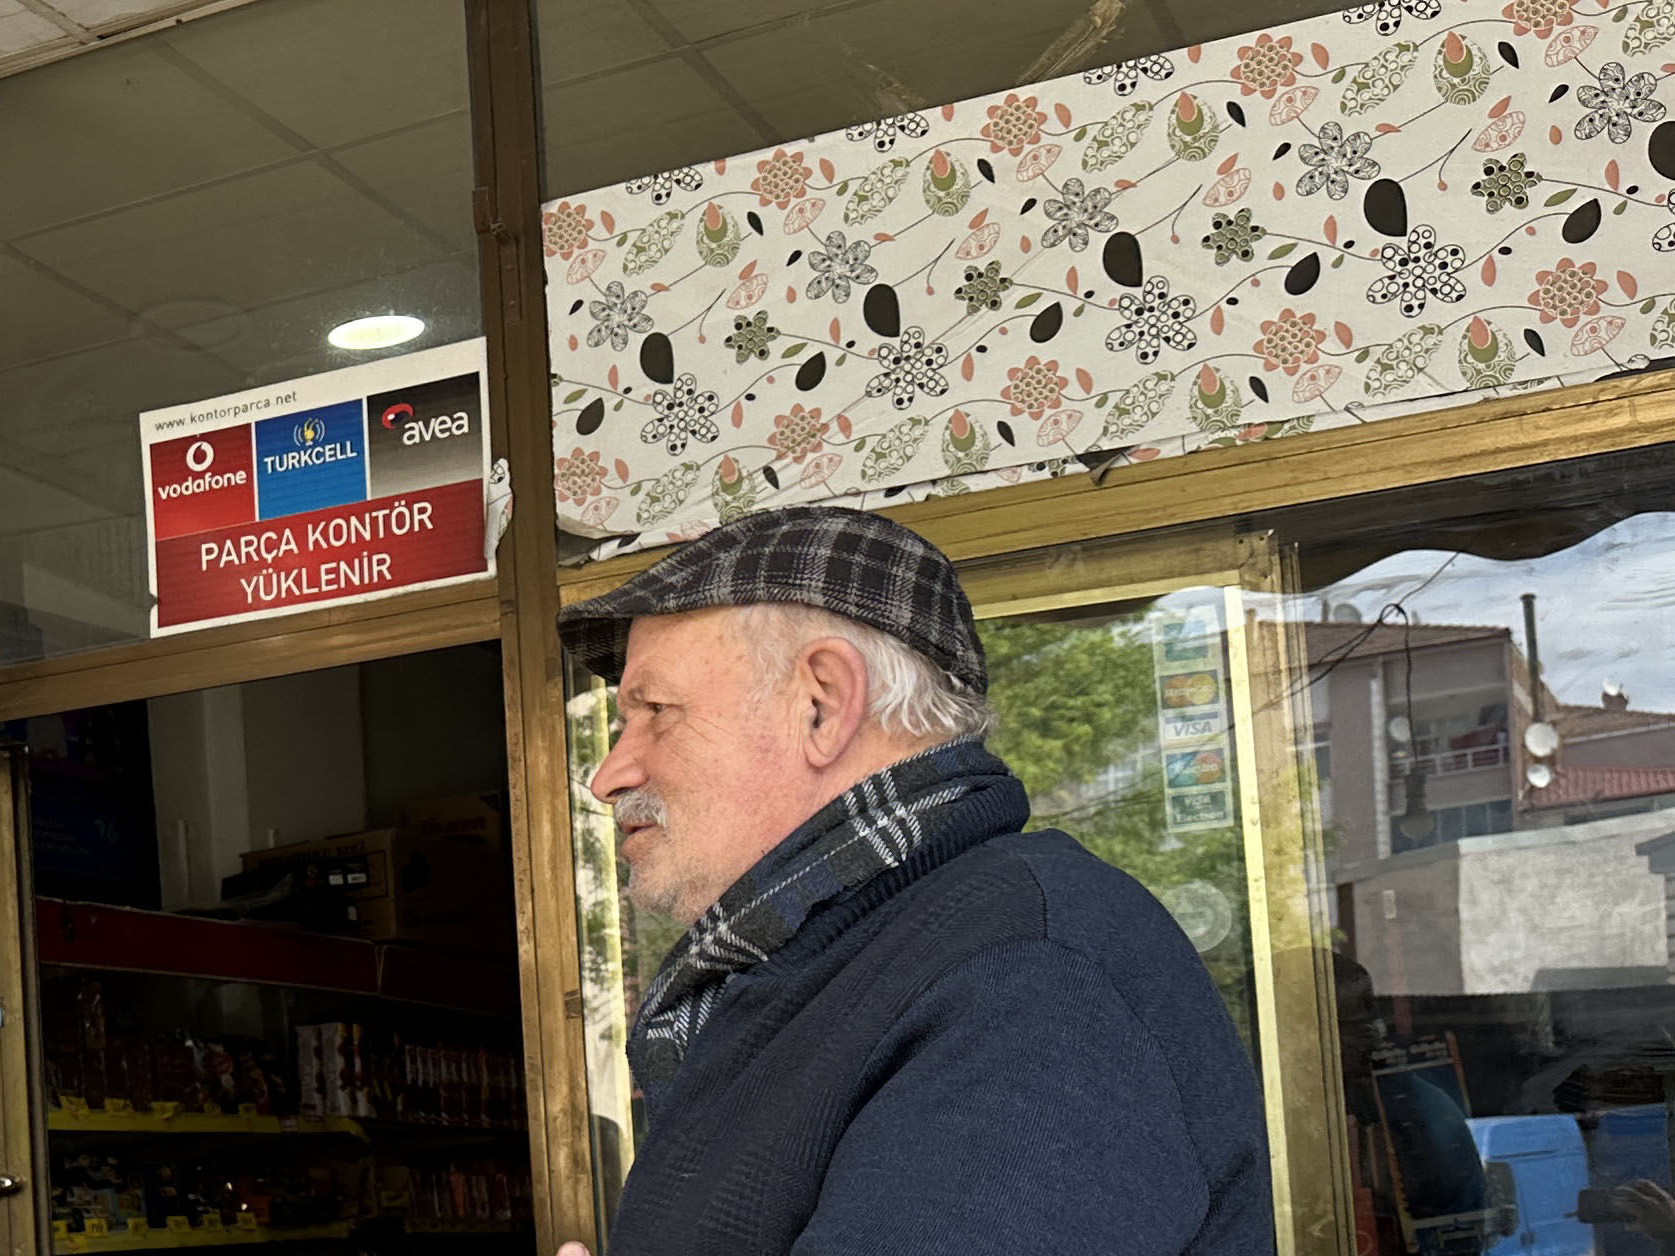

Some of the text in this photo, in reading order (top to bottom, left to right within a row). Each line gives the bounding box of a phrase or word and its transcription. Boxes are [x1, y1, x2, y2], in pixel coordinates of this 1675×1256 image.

[401, 409, 471, 447] avea
[263, 439, 359, 475] TURKCELL
[157, 469, 248, 501] vodafone
[200, 500, 435, 572] PARÇA KONTÖR
[240, 551, 394, 605] YÜKLENİR
[1173, 720, 1214, 737] VISA
